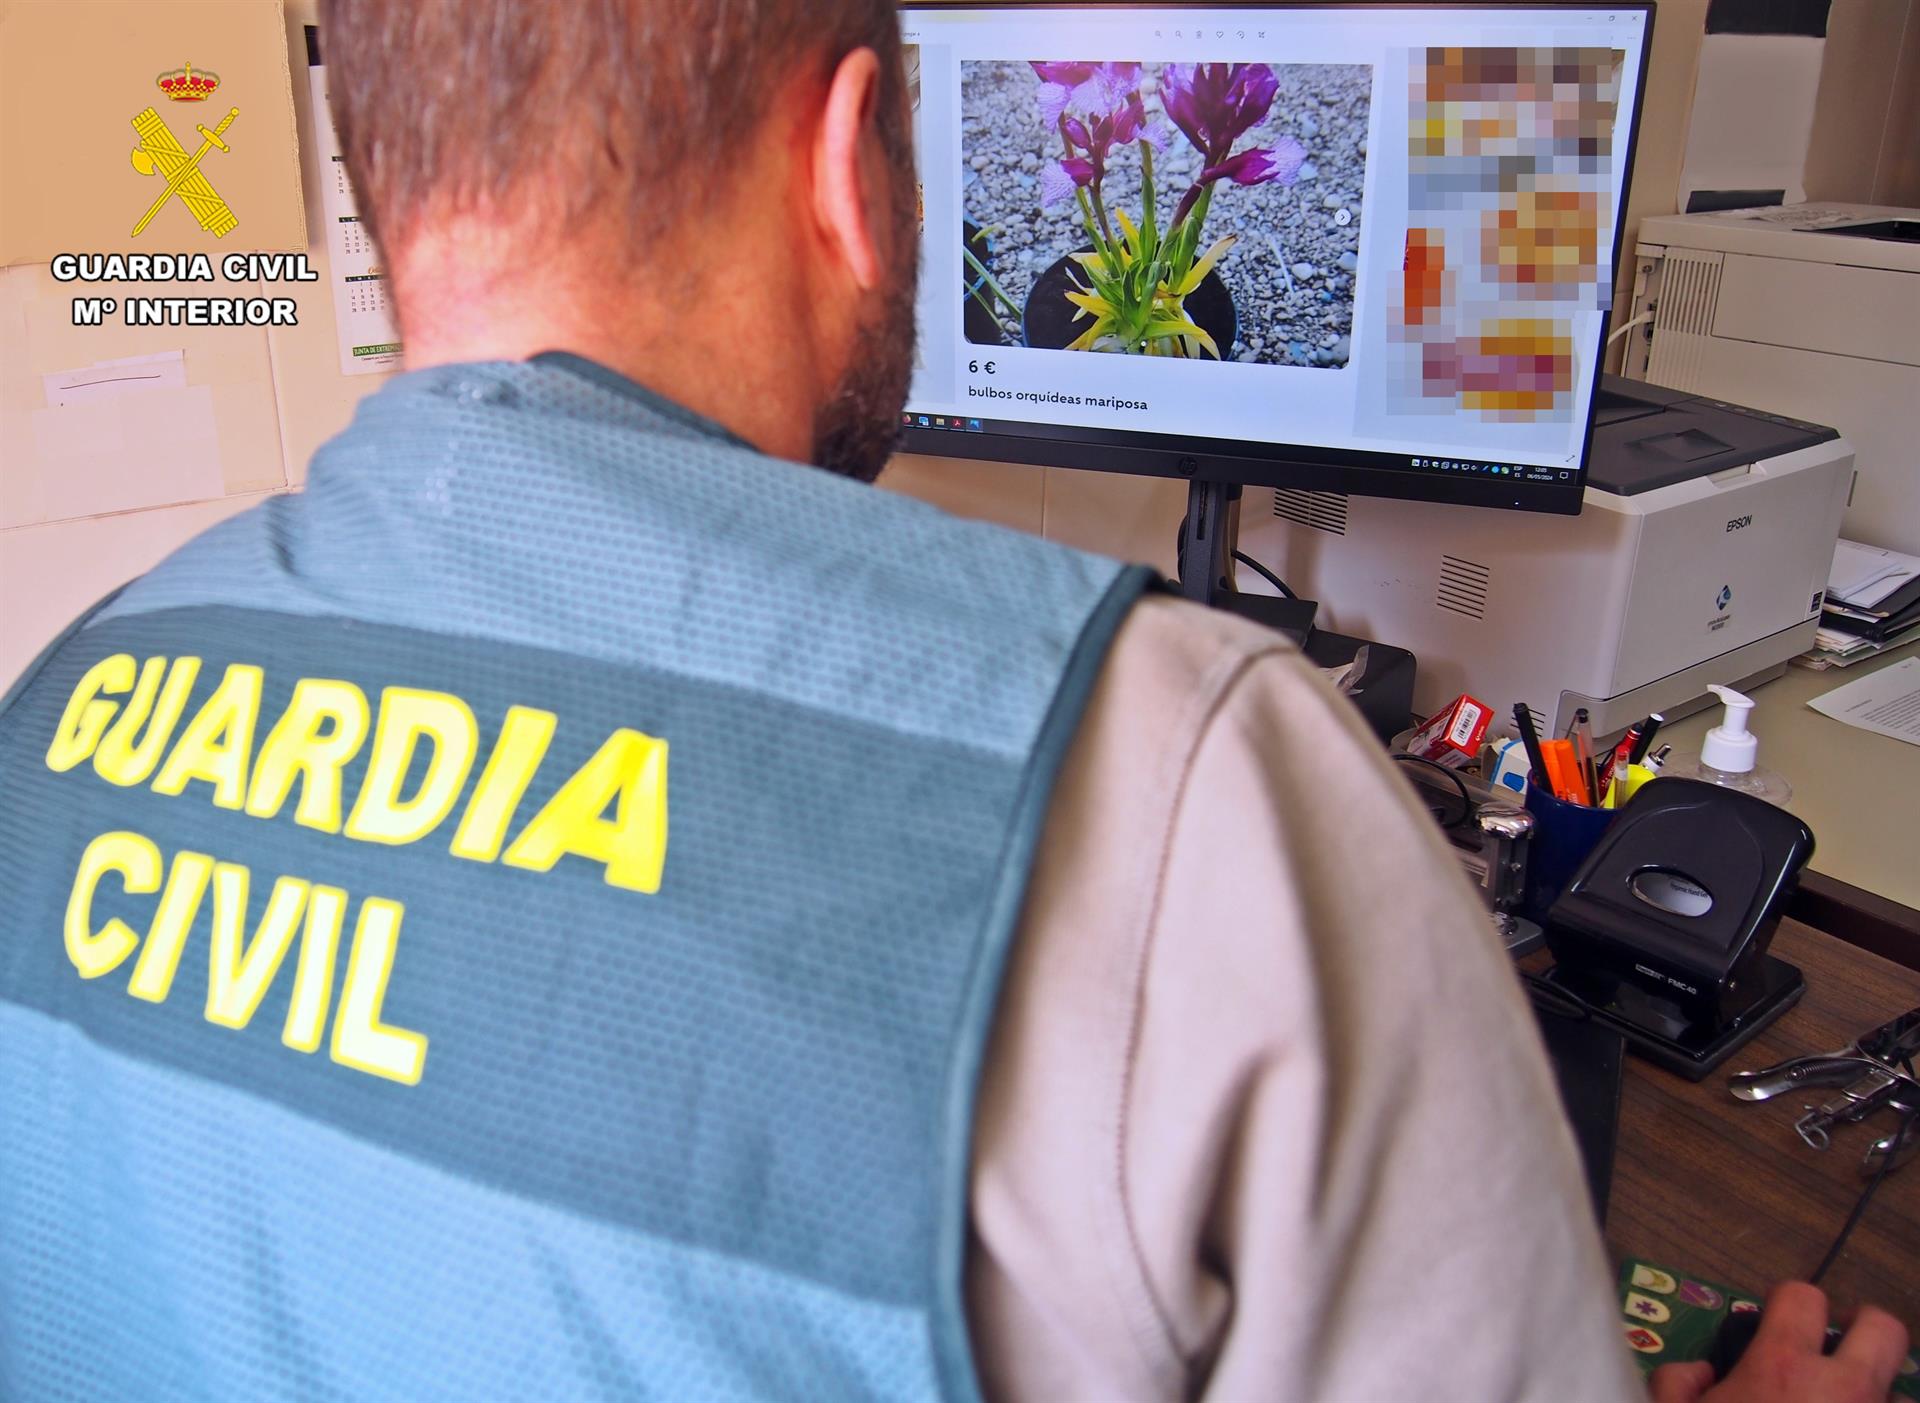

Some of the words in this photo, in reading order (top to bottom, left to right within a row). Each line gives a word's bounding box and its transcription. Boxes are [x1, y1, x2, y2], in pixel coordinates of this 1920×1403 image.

[968, 360, 979, 374] 6
[984, 361, 996, 375] €
[968, 385, 1013, 400] bulbos
[1015, 390, 1082, 405] orquídeas
[1084, 396, 1149, 411] mariposa
[1726, 514, 1753, 533] EPSON
[46, 654, 669, 894] GUARDIA
[63, 831, 428, 1087] CIVIL
